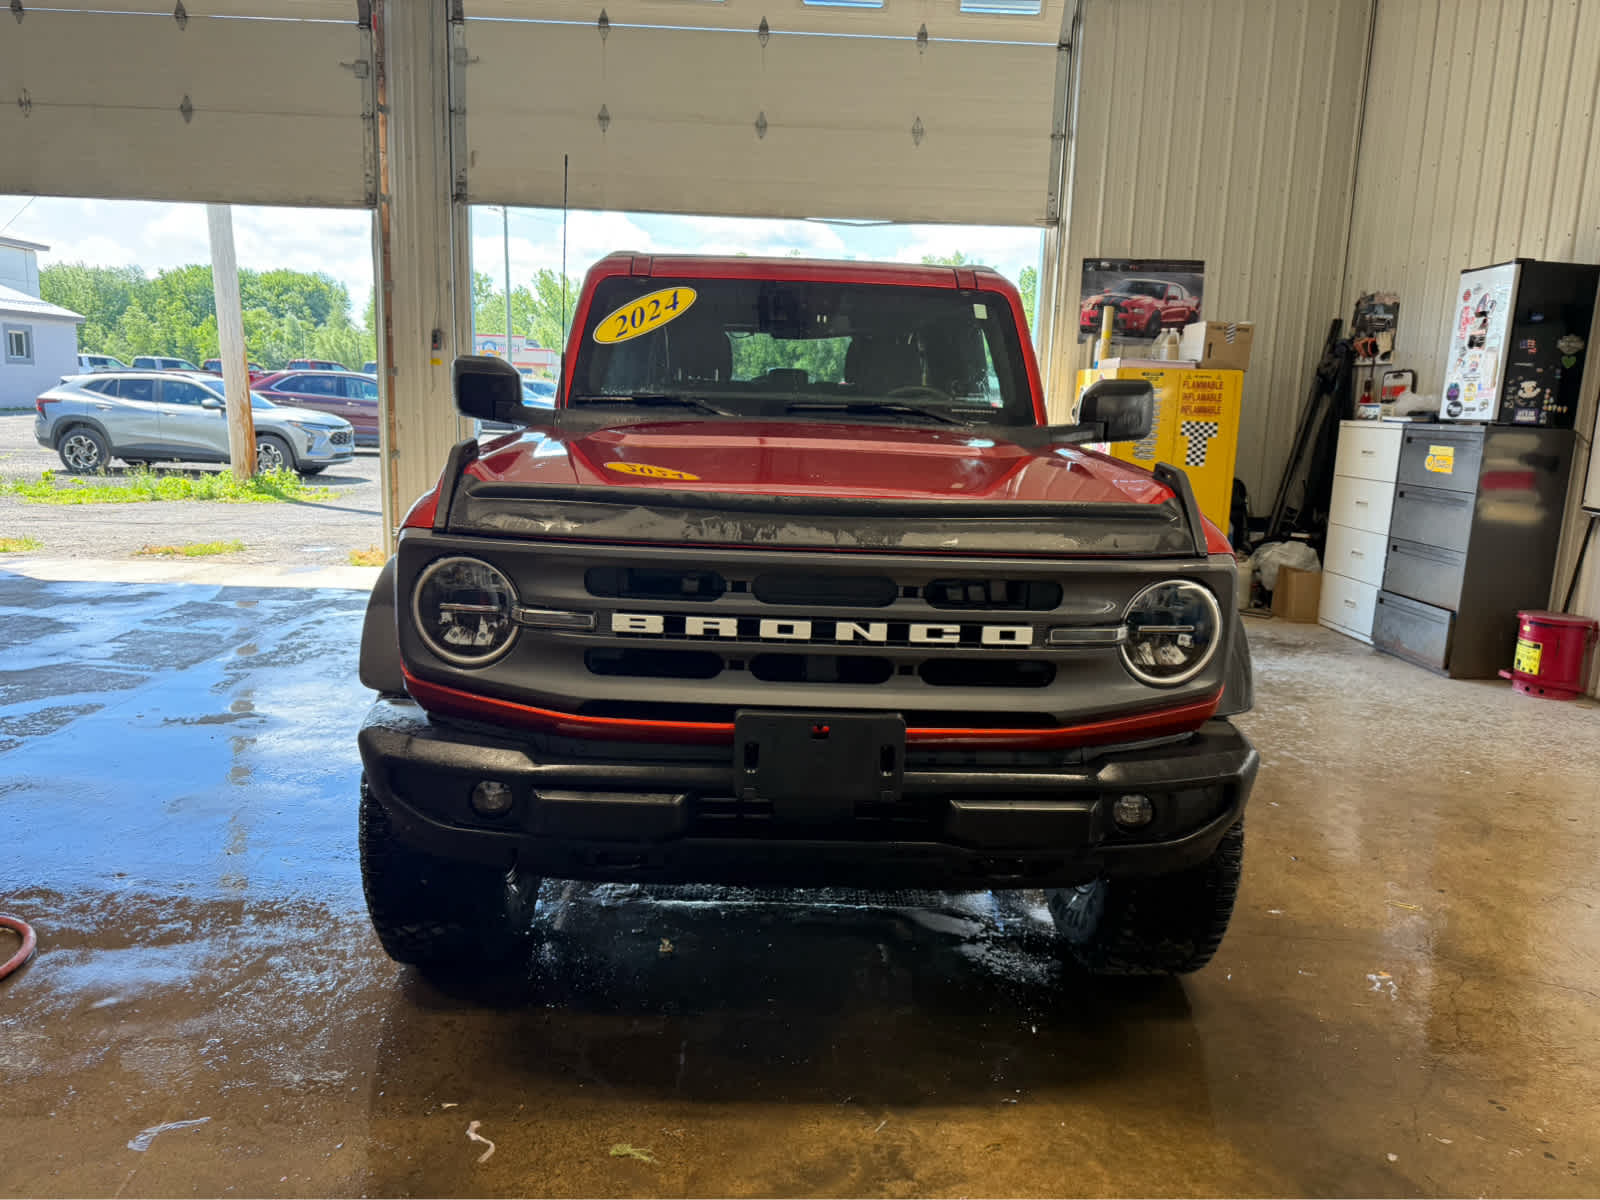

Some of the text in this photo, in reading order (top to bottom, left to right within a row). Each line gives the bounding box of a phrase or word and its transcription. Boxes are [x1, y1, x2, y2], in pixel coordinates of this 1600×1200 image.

[615, 290, 679, 338] 2024
[1183, 380, 1224, 391] FLAMMABLE
[612, 613, 1033, 645] BRONCO
